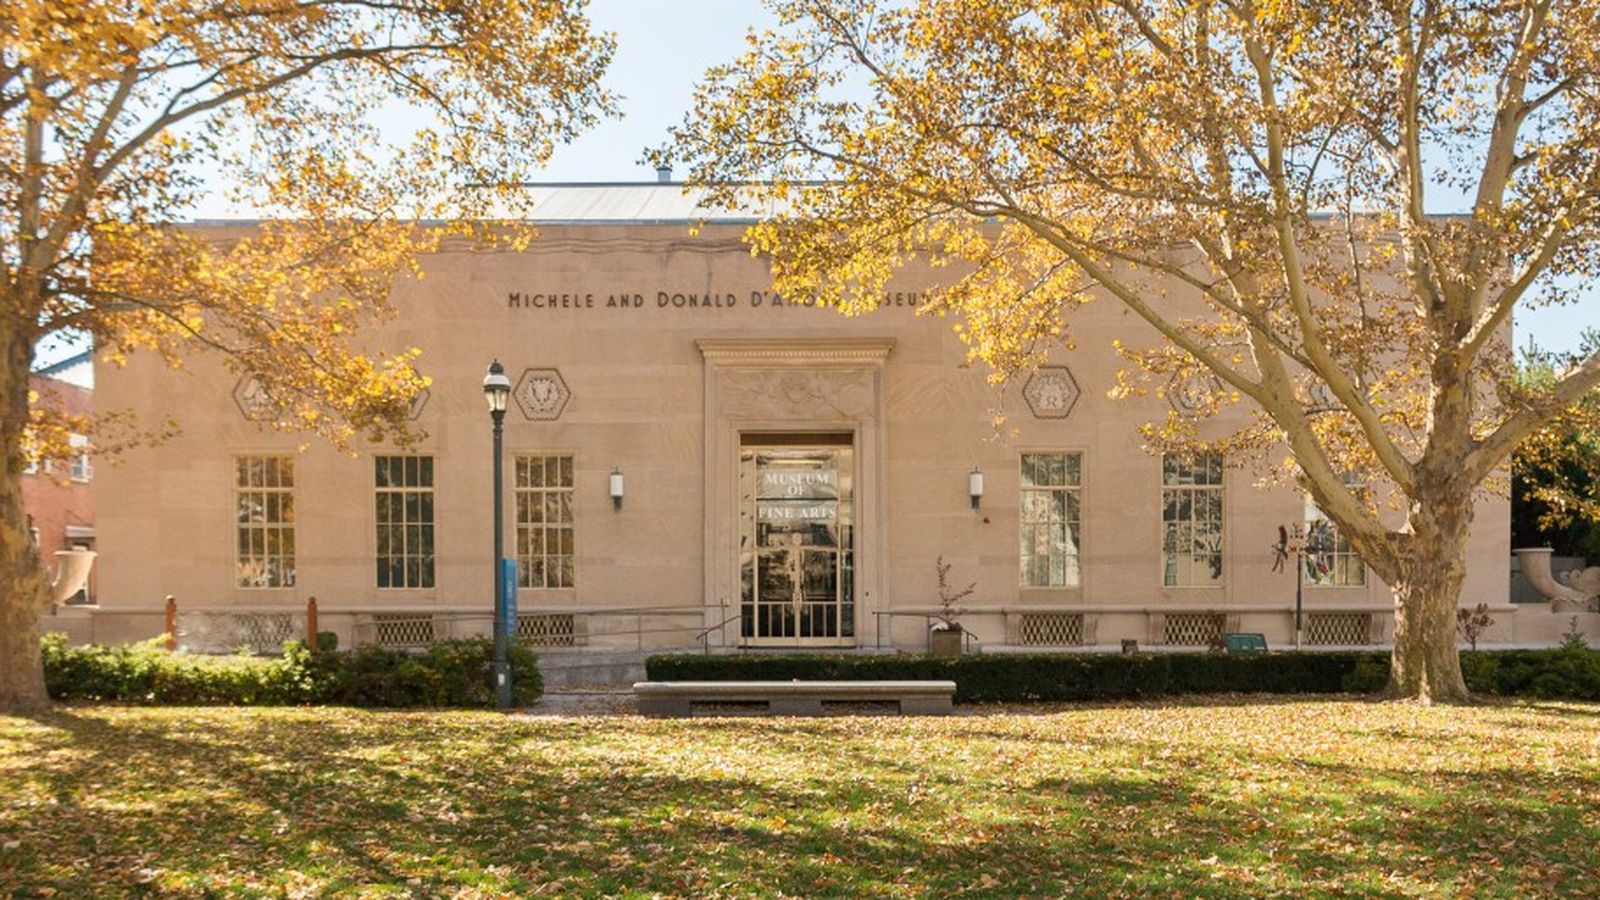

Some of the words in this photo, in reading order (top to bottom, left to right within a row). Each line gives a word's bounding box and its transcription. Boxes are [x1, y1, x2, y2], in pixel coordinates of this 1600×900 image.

[508, 292, 594, 308] MICHELE
[606, 294, 645, 308] AND
[657, 291, 737, 308] DONALD
[751, 290, 842, 308] D'AMO
[766, 473, 829, 485] MUSEUM
[787, 486, 806, 496] OF
[759, 507, 793, 519] FINE
[799, 507, 836, 519] ARTS
